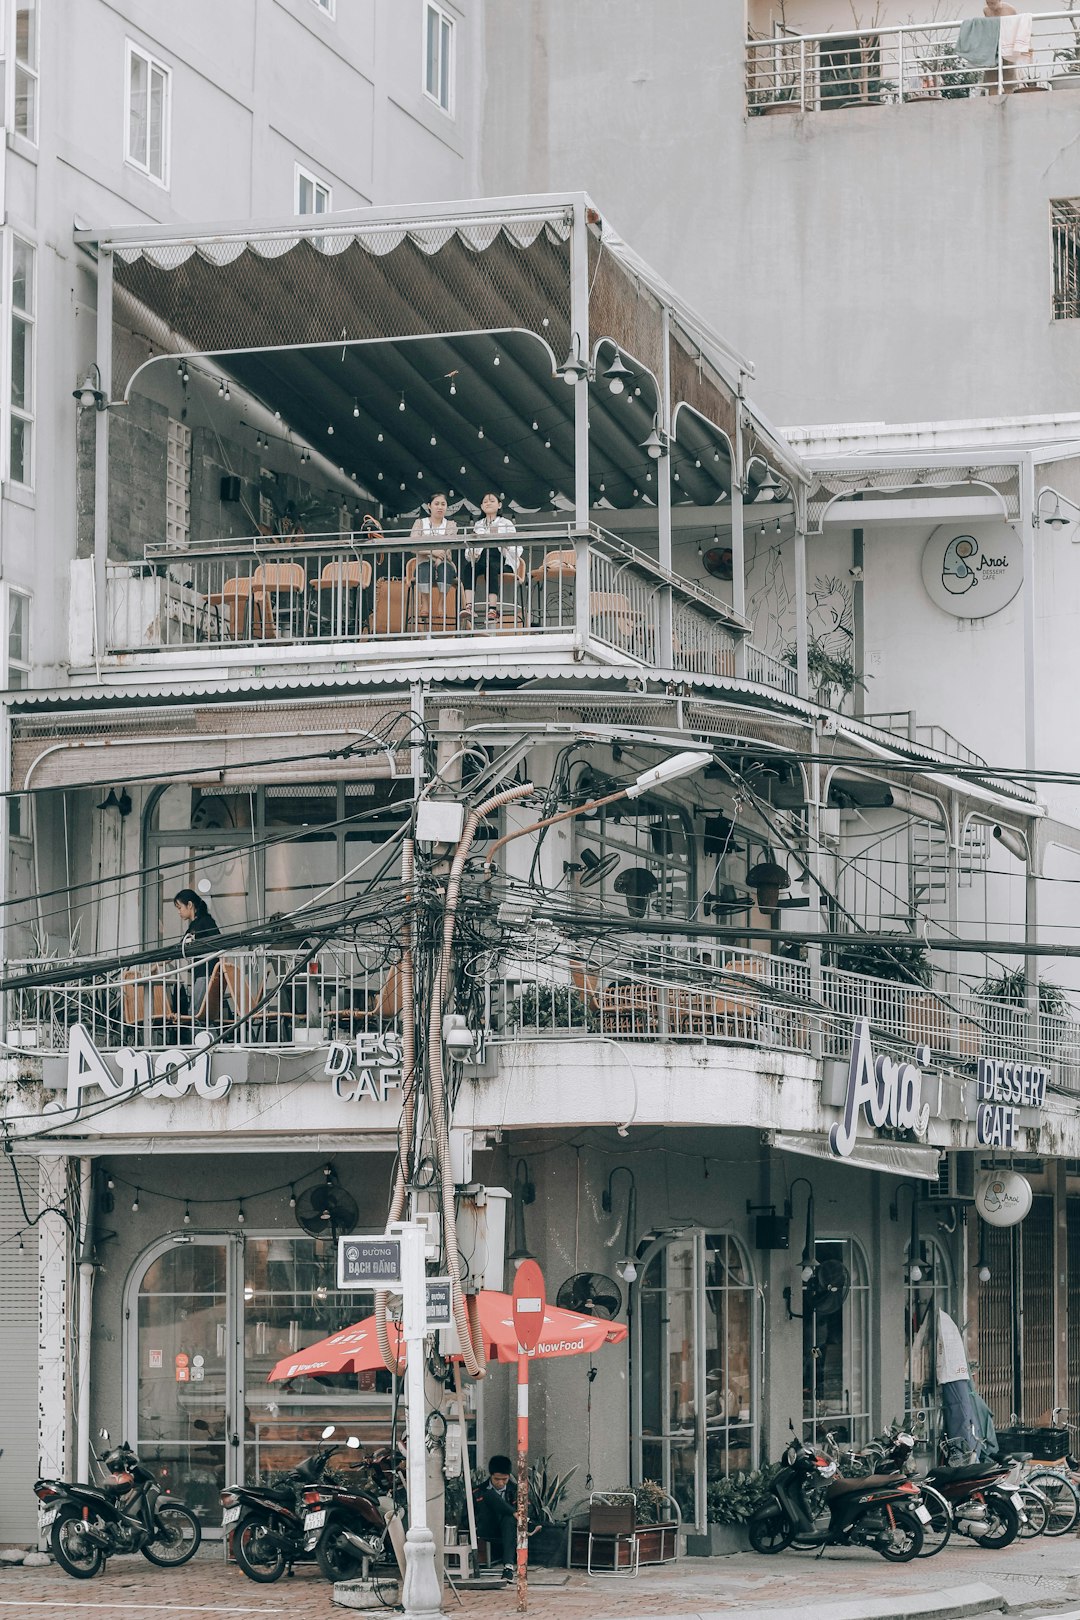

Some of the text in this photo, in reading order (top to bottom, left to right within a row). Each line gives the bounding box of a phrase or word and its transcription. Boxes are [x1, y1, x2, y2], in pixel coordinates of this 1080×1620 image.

[976, 554, 1009, 571] Aroi
[43, 1023, 233, 1121] Aroi
[829, 1016, 930, 1157] Aroi
[977, 1057, 1051, 1107] DESSERT
[362, 1247, 392, 1257] ĐƯỜNG
[348, 1261, 371, 1276] BẠCH
[538, 1338, 584, 1354] NowFood
